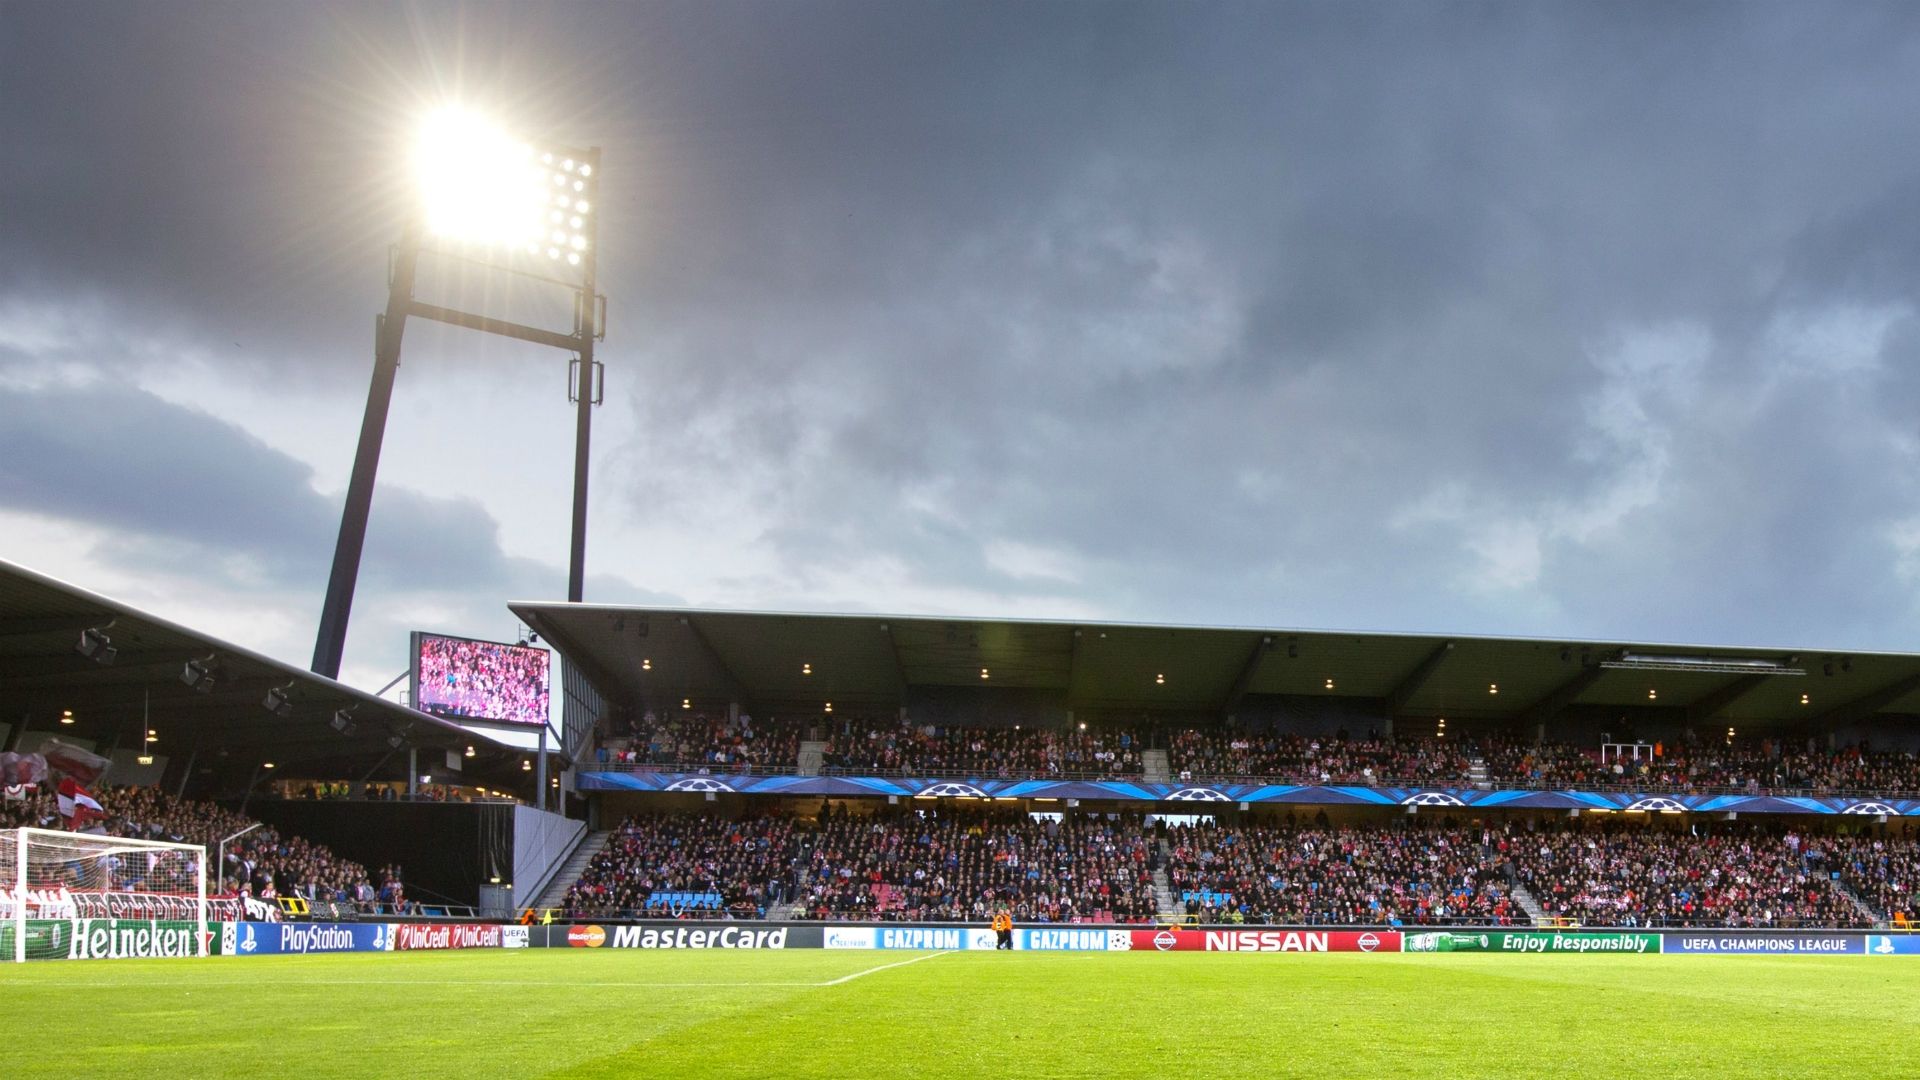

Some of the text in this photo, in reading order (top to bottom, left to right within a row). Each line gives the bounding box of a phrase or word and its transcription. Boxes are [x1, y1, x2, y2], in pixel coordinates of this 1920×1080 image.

[67, 918, 192, 959] Heineken
[281, 924, 354, 953] PlayStation
[410, 925, 449, 949] UniCredit
[462, 926, 498, 947] UniCredit
[504, 929, 526, 937] UEFA
[612, 925, 788, 949] MasterCard
[884, 929, 960, 949] GAZPROM
[1030, 930, 1105, 949] GAZPROM
[1205, 932, 1328, 951] NISSAN
[1502, 934, 1648, 952] Enjoy Responsibly
[1683, 938, 1847, 951] UEFA CHAMPIONS LEAGUE
